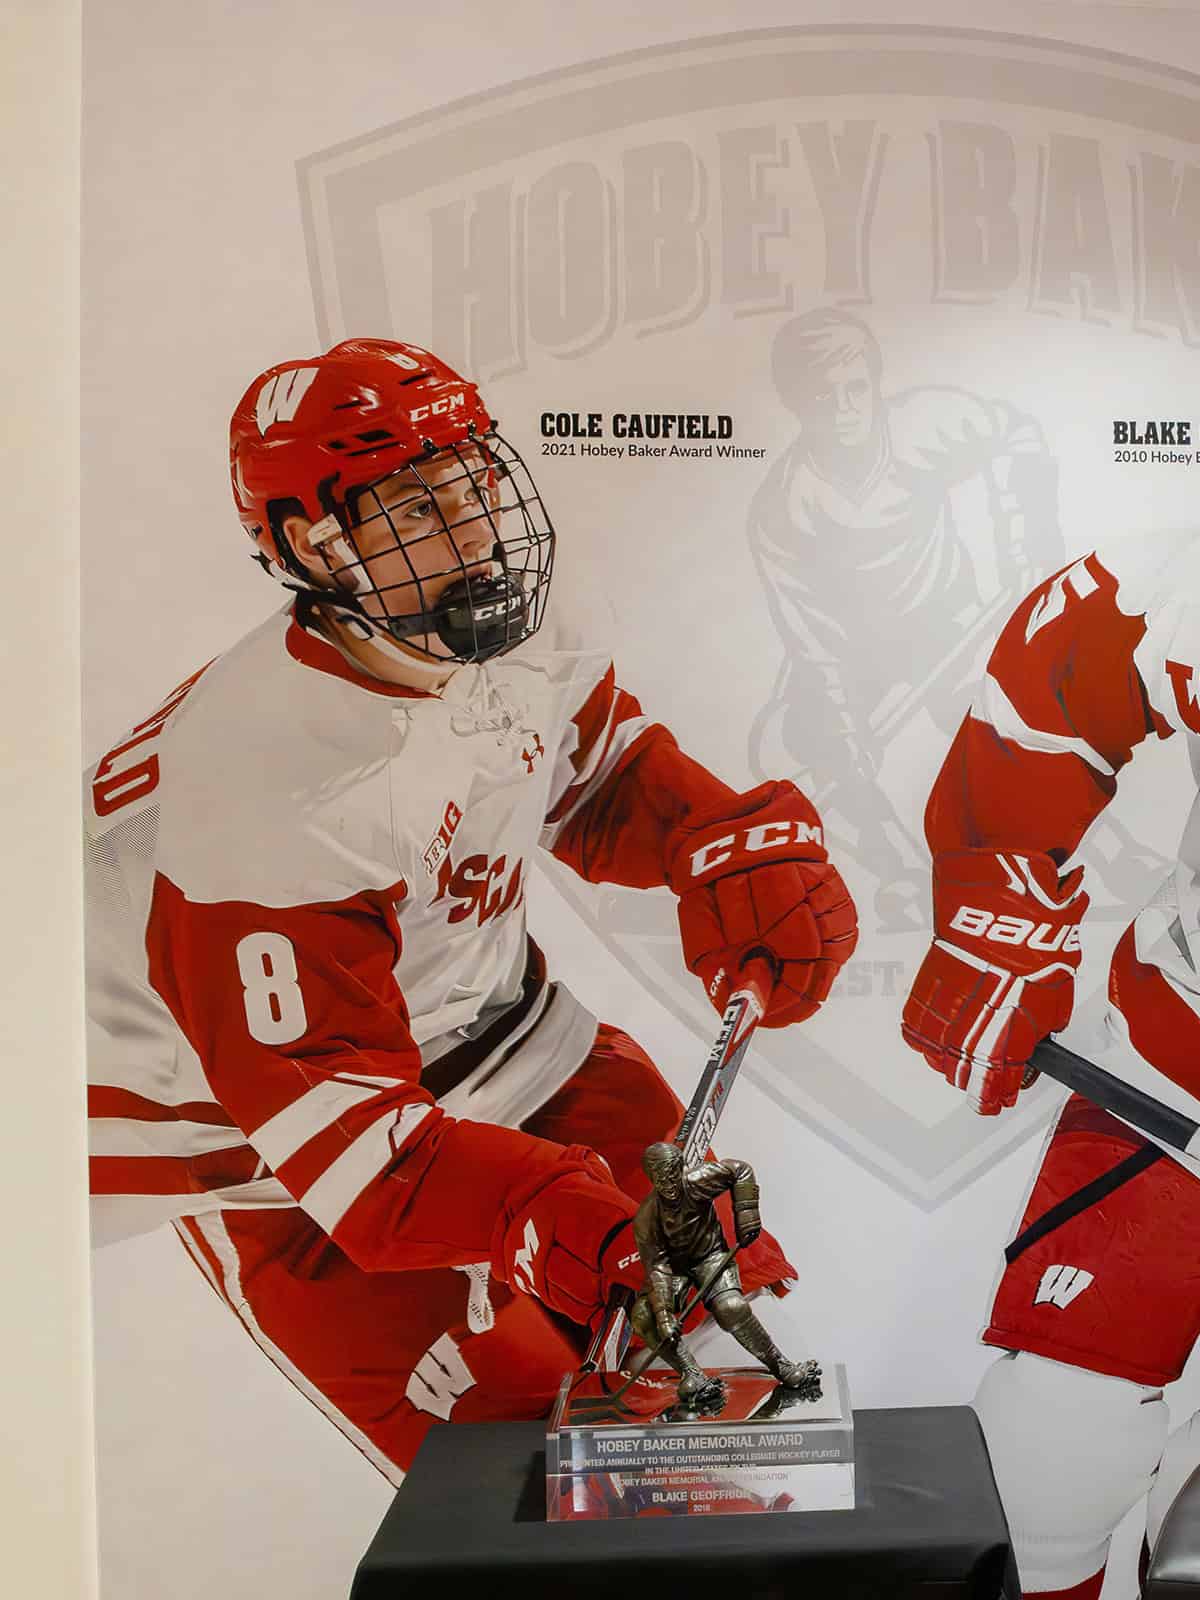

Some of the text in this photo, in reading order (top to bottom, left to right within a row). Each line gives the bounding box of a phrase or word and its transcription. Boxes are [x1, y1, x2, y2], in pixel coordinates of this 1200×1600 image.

[427, 119, 889, 384] HOBEY
[409, 392, 465, 422] CCM
[540, 412, 733, 439] COLE CAUFIELD
[1113, 421, 1191, 446] BLAKE
[541, 443, 766, 458] 2021 Hobey Baker Award Winner
[1114, 450, 1147, 463] 2010
[1152, 450, 1193, 466] Hobey
[689, 821, 823, 877] CCM
[235, 931, 308, 1046] 8
[617, 1251, 641, 1270] CC
[1033, 1263, 1095, 1310] W
[597, 1433, 804, 1453] HOBEY BAKER MEMORIAL AWARD
[652, 1491, 688, 1503] BLAKE
